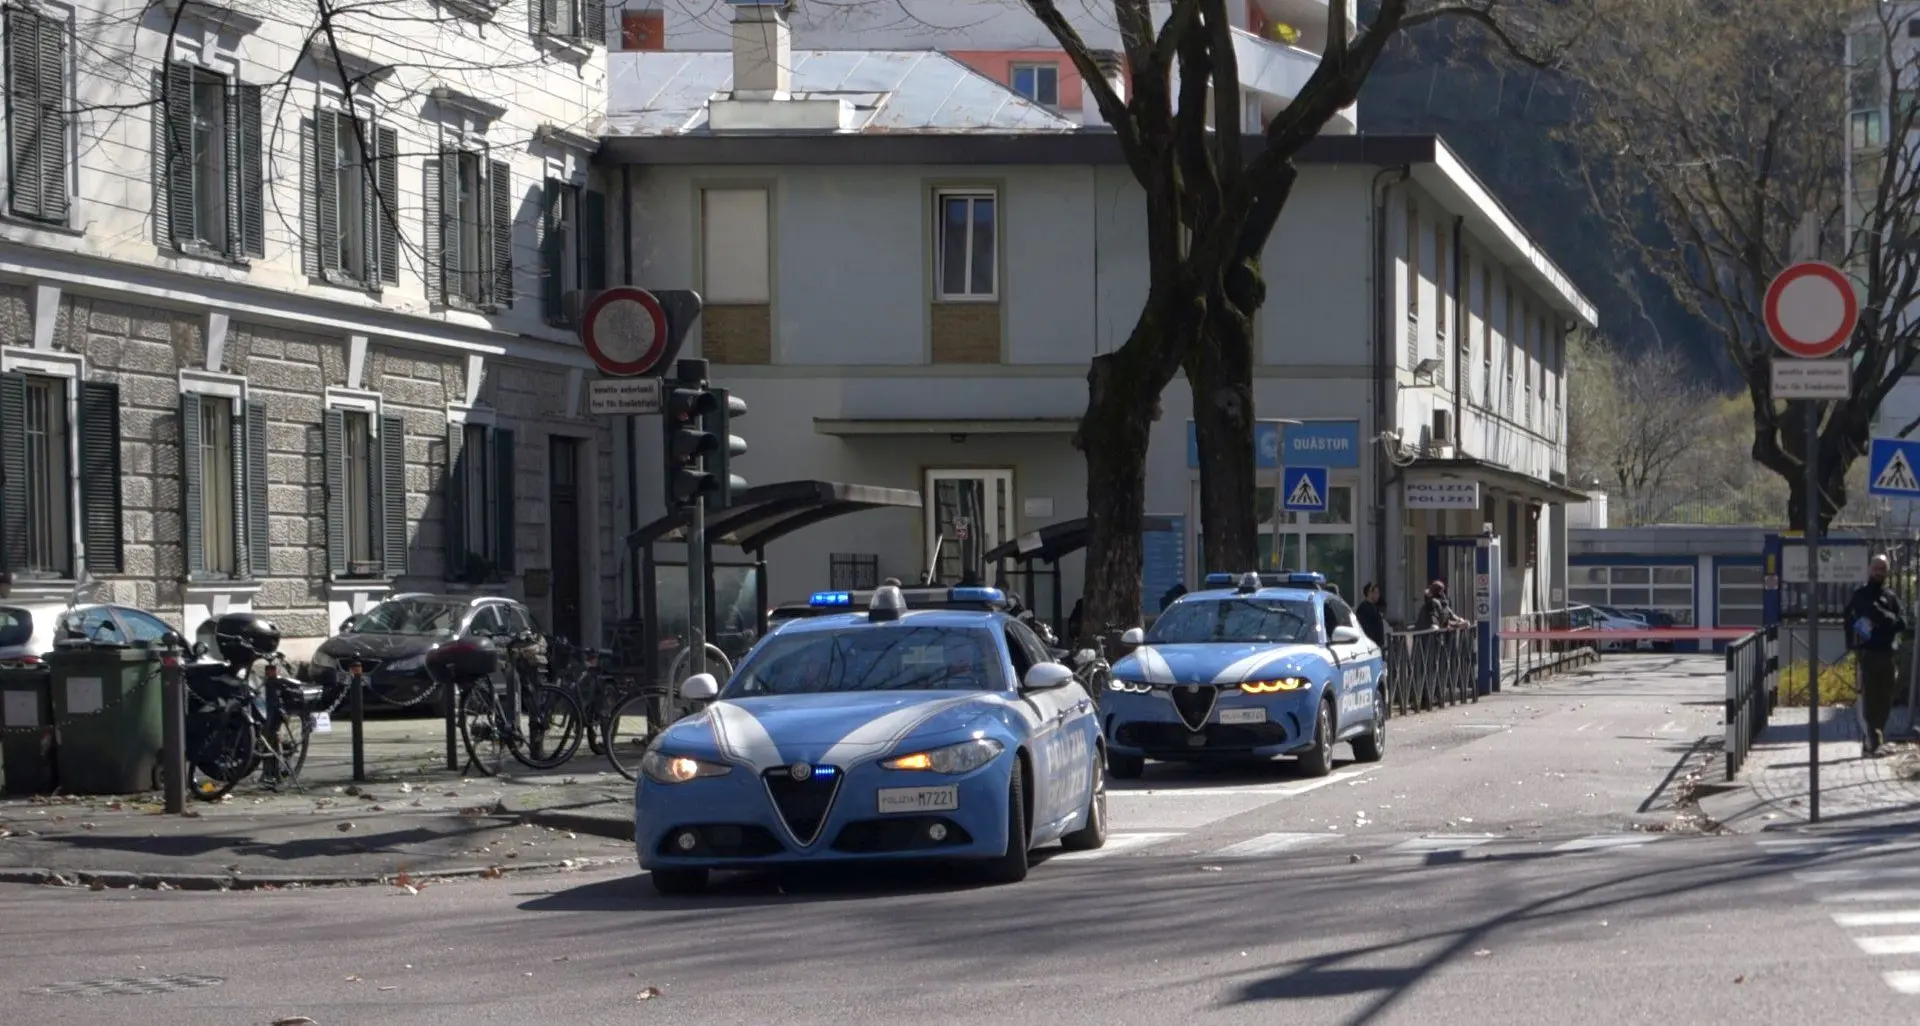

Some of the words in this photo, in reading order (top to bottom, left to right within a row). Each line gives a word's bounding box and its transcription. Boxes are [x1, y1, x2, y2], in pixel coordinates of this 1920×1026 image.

[1293, 436, 1350, 450] QUÄSTUR
[1407, 484, 1475, 492] POLIZIA
[1408, 495, 1474, 503] POLIZEI
[917, 791, 954, 807] M7221
